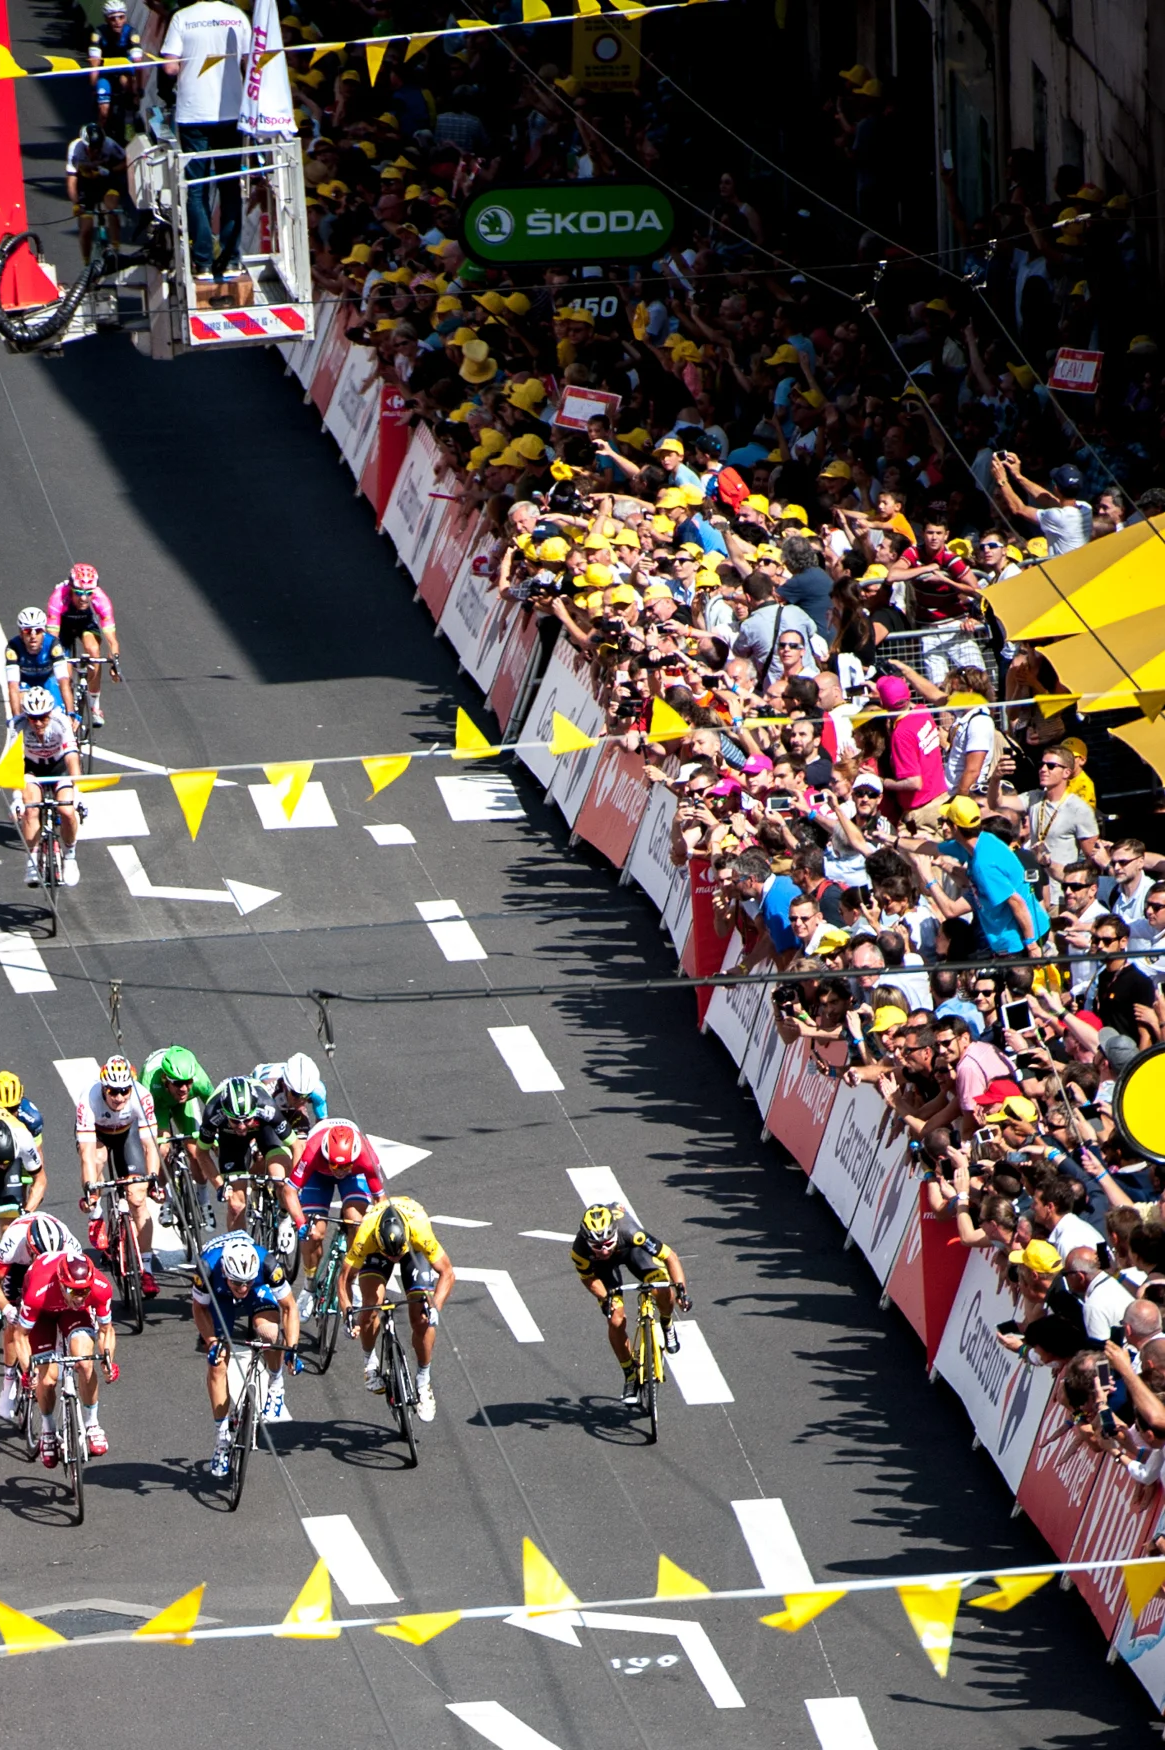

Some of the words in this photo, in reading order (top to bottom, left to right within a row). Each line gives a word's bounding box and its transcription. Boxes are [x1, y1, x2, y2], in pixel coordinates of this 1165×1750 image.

[526, 208, 664, 236] ŠKODA
[834, 1098, 886, 1209] Carrefour
[959, 1289, 1012, 1407] Carrefour
